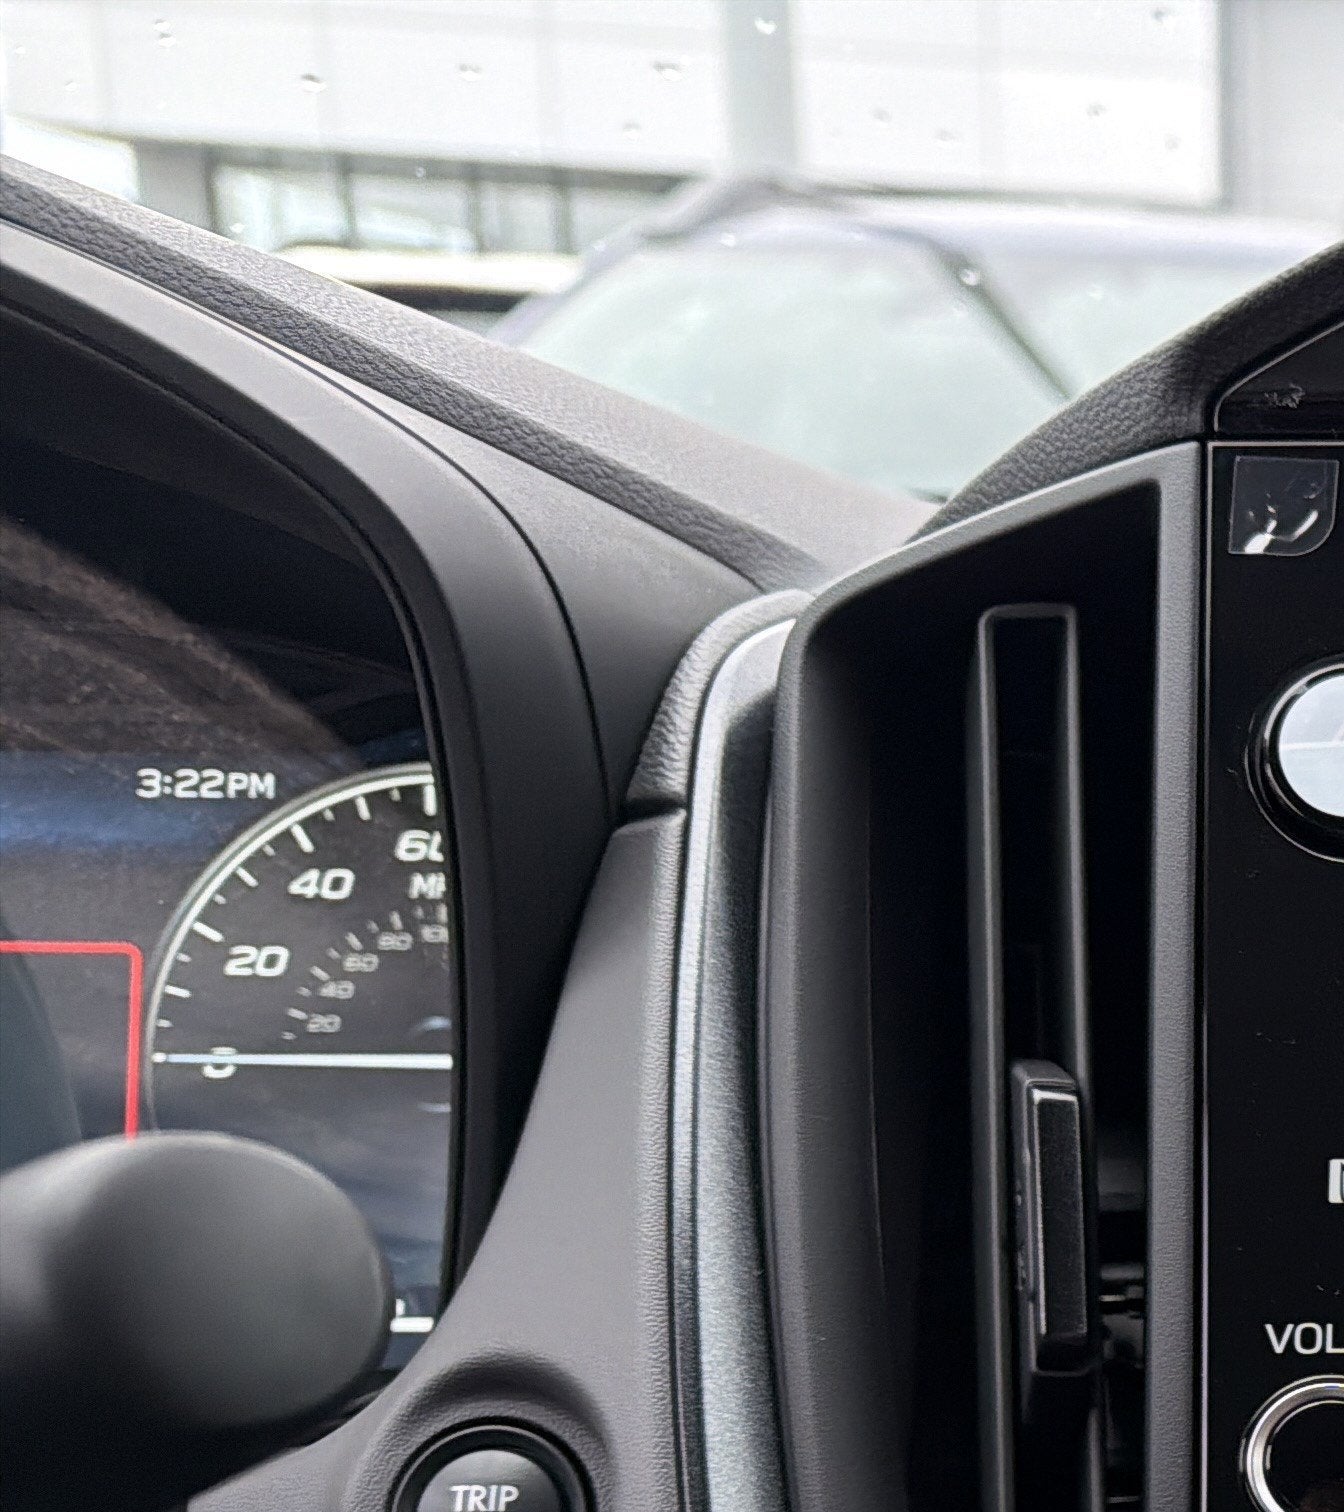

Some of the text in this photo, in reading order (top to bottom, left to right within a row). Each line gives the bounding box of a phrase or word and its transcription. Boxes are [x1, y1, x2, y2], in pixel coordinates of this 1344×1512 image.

[288, 867, 356, 900] 40
[223, 944, 290, 977] 20
[448, 1484, 519, 1512] TRIP
